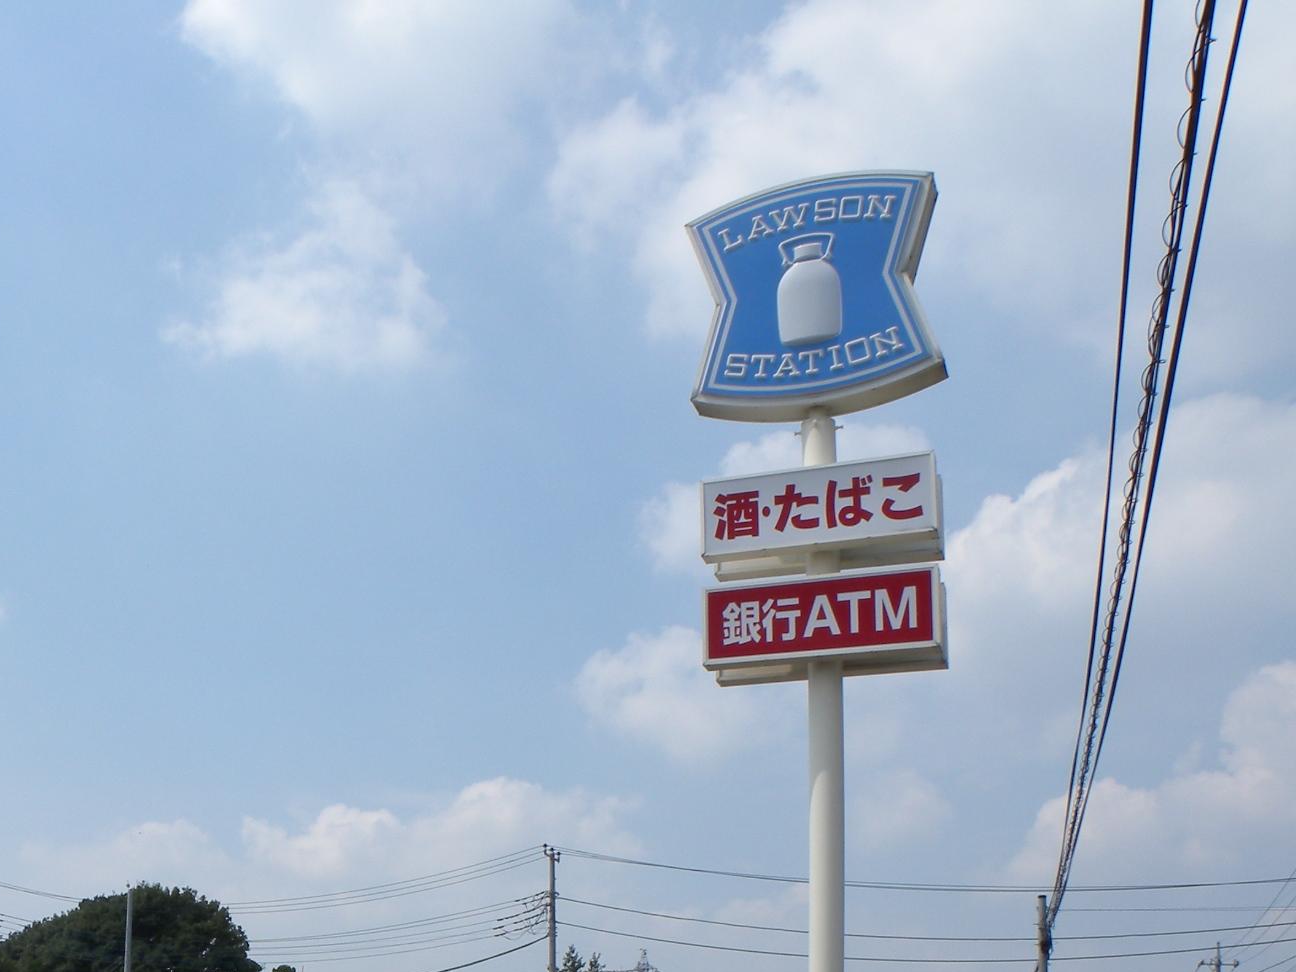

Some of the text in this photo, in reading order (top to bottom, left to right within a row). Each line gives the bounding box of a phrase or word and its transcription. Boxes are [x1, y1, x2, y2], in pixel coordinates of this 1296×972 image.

[717, 195, 896, 253] LAWSON
[724, 326, 903, 381] STATION
[722, 585, 918, 646] 銀行ATM
